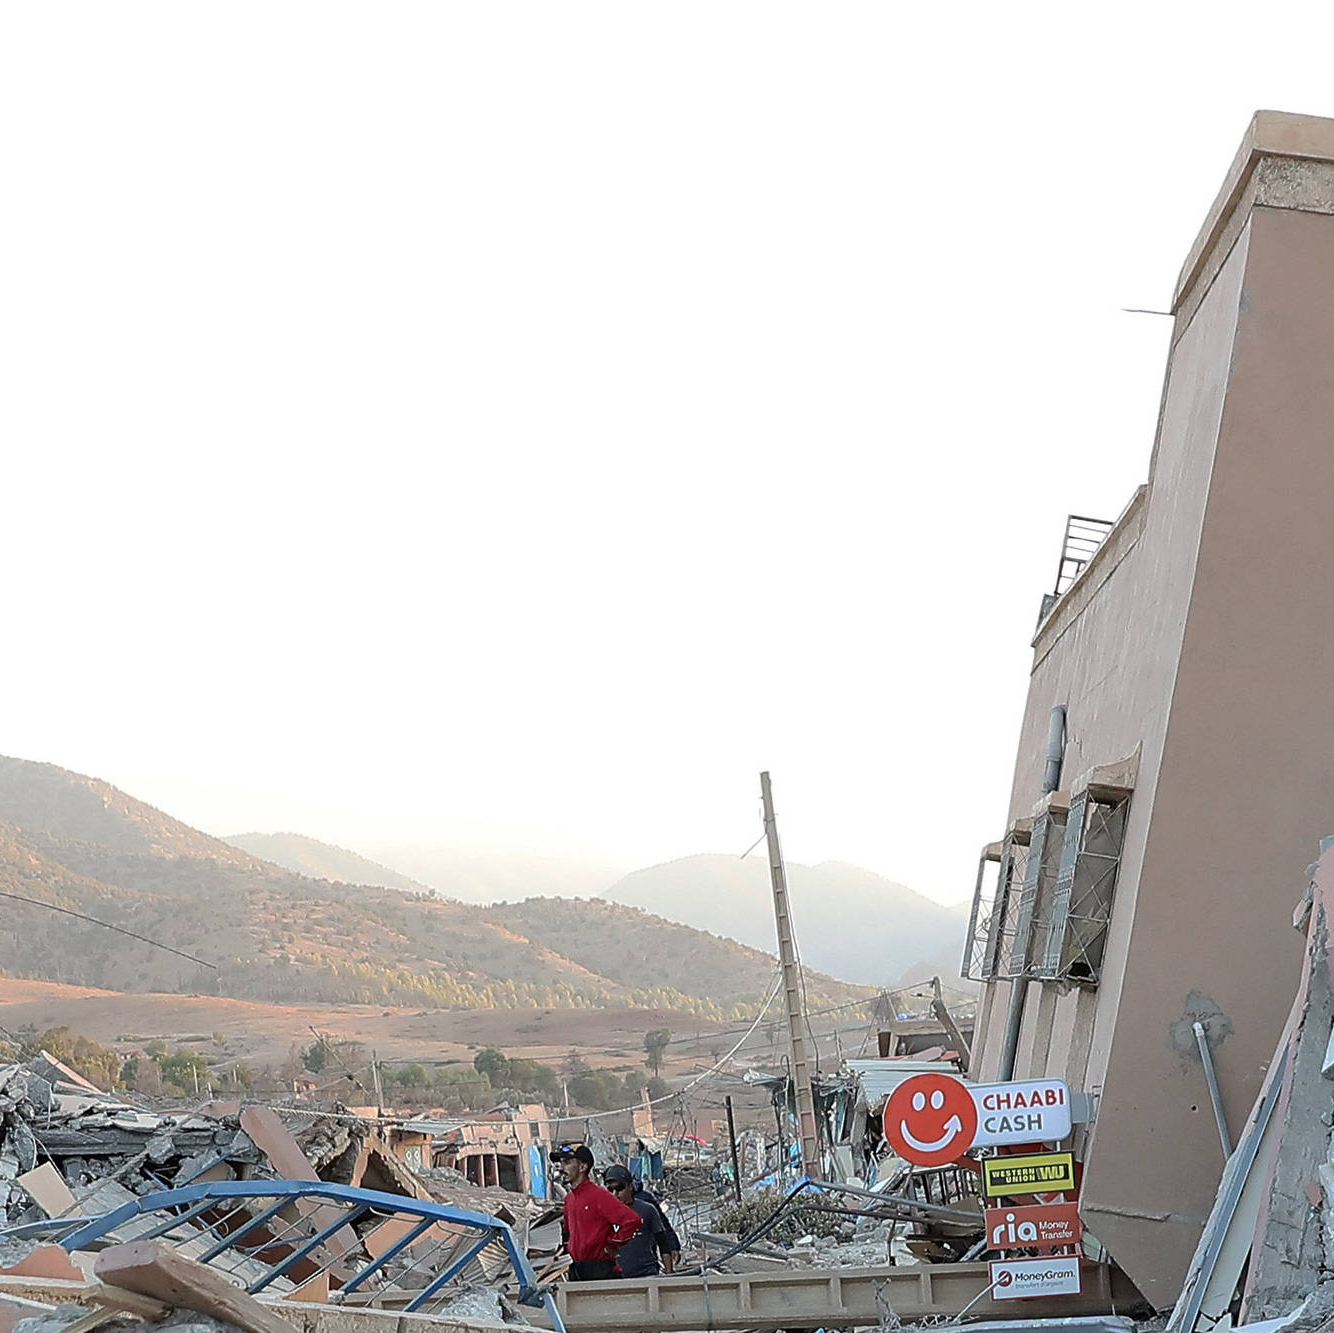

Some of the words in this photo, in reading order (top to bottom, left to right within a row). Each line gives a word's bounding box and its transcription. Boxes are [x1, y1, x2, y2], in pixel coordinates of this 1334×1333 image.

[983, 1088, 1064, 1111] CHAABI
[984, 1113, 1042, 1133] CASH
[992, 1168, 1035, 1178] WESTERN
[1040, 1165, 1064, 1180] WU
[1005, 1175, 1035, 1183] UNION
[993, 1213, 1037, 1244] ria
[1039, 1221, 1069, 1230] Money
[1041, 1230, 1073, 1240] Transfer
